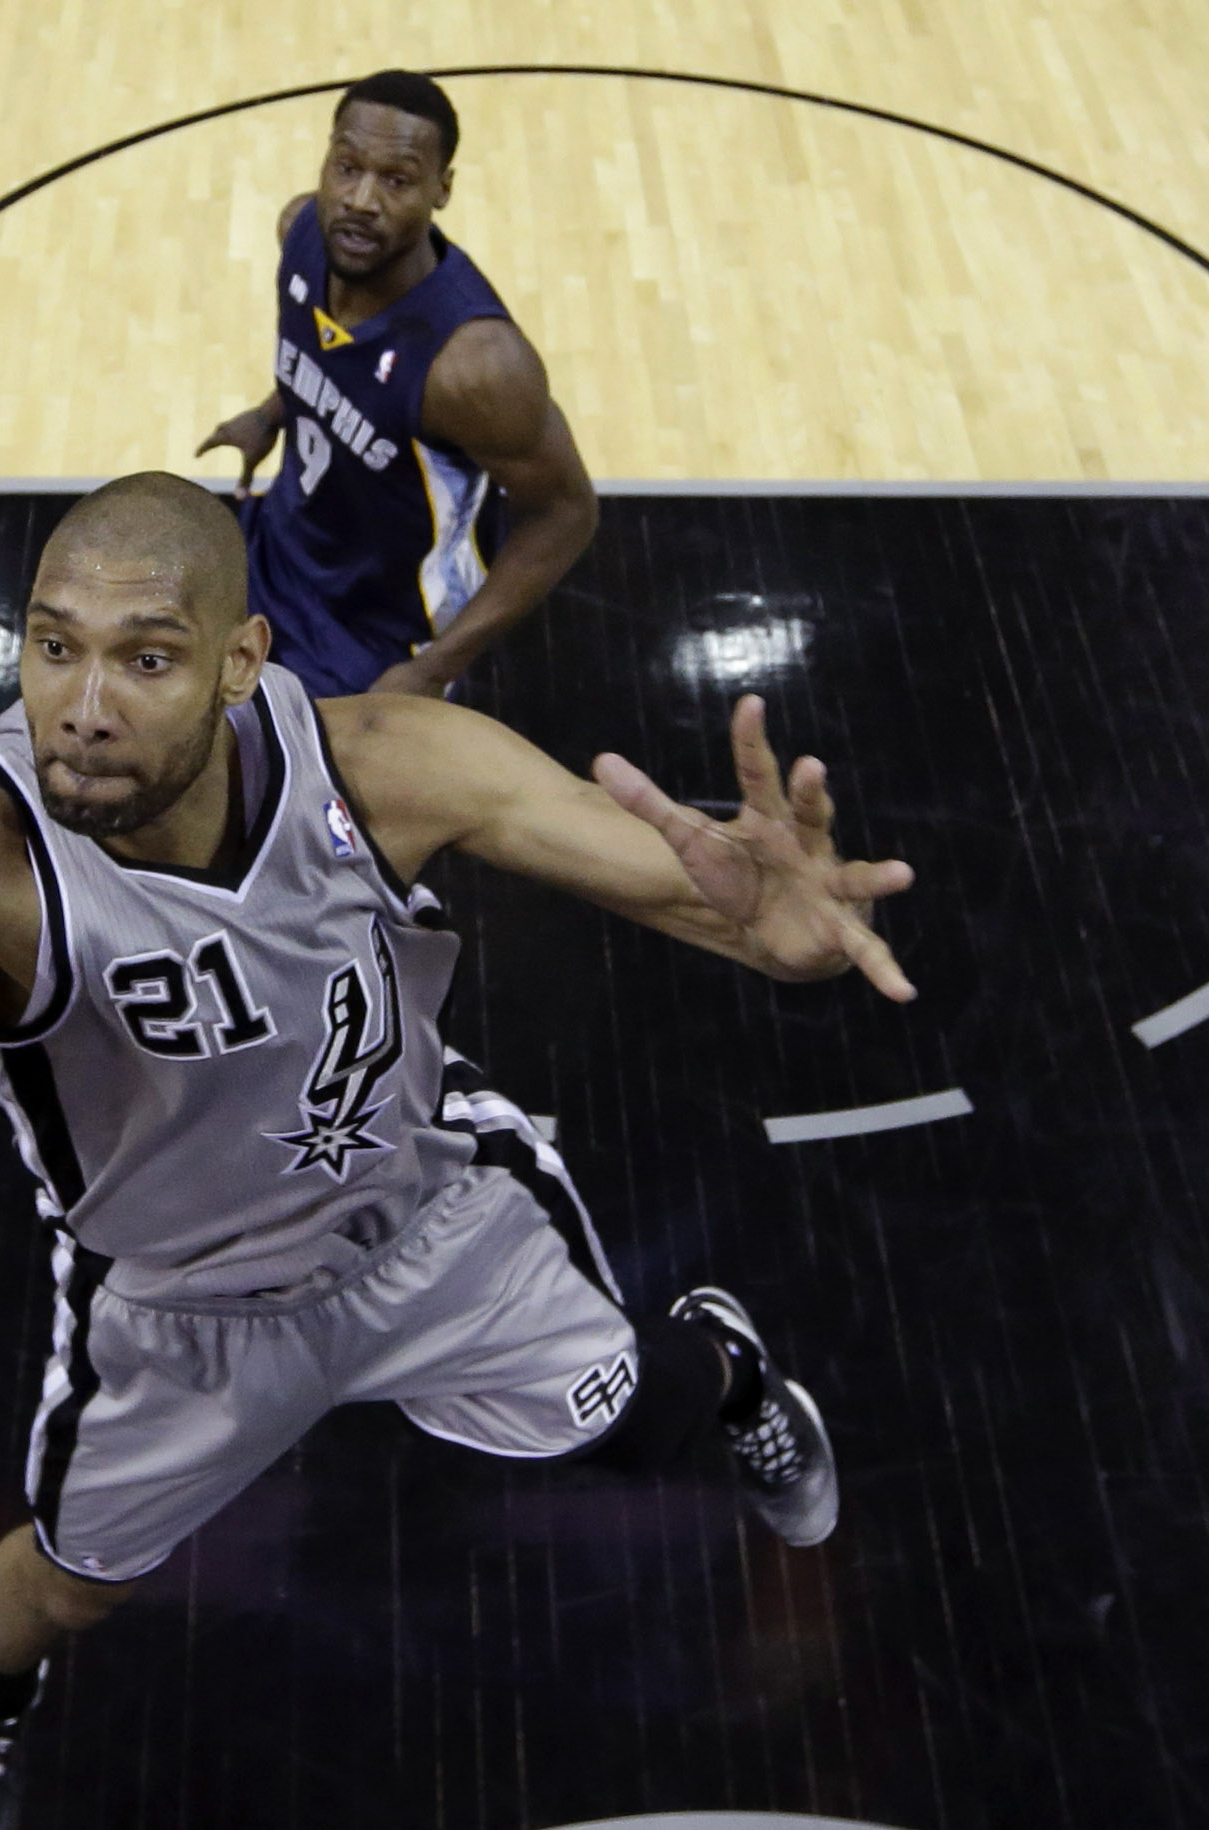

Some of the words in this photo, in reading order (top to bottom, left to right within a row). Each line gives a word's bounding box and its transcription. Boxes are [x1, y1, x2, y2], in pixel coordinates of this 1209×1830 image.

[276, 338, 398, 471] EMPHIS
[297, 416, 332, 495] 9
[102, 929, 279, 1061] 21
